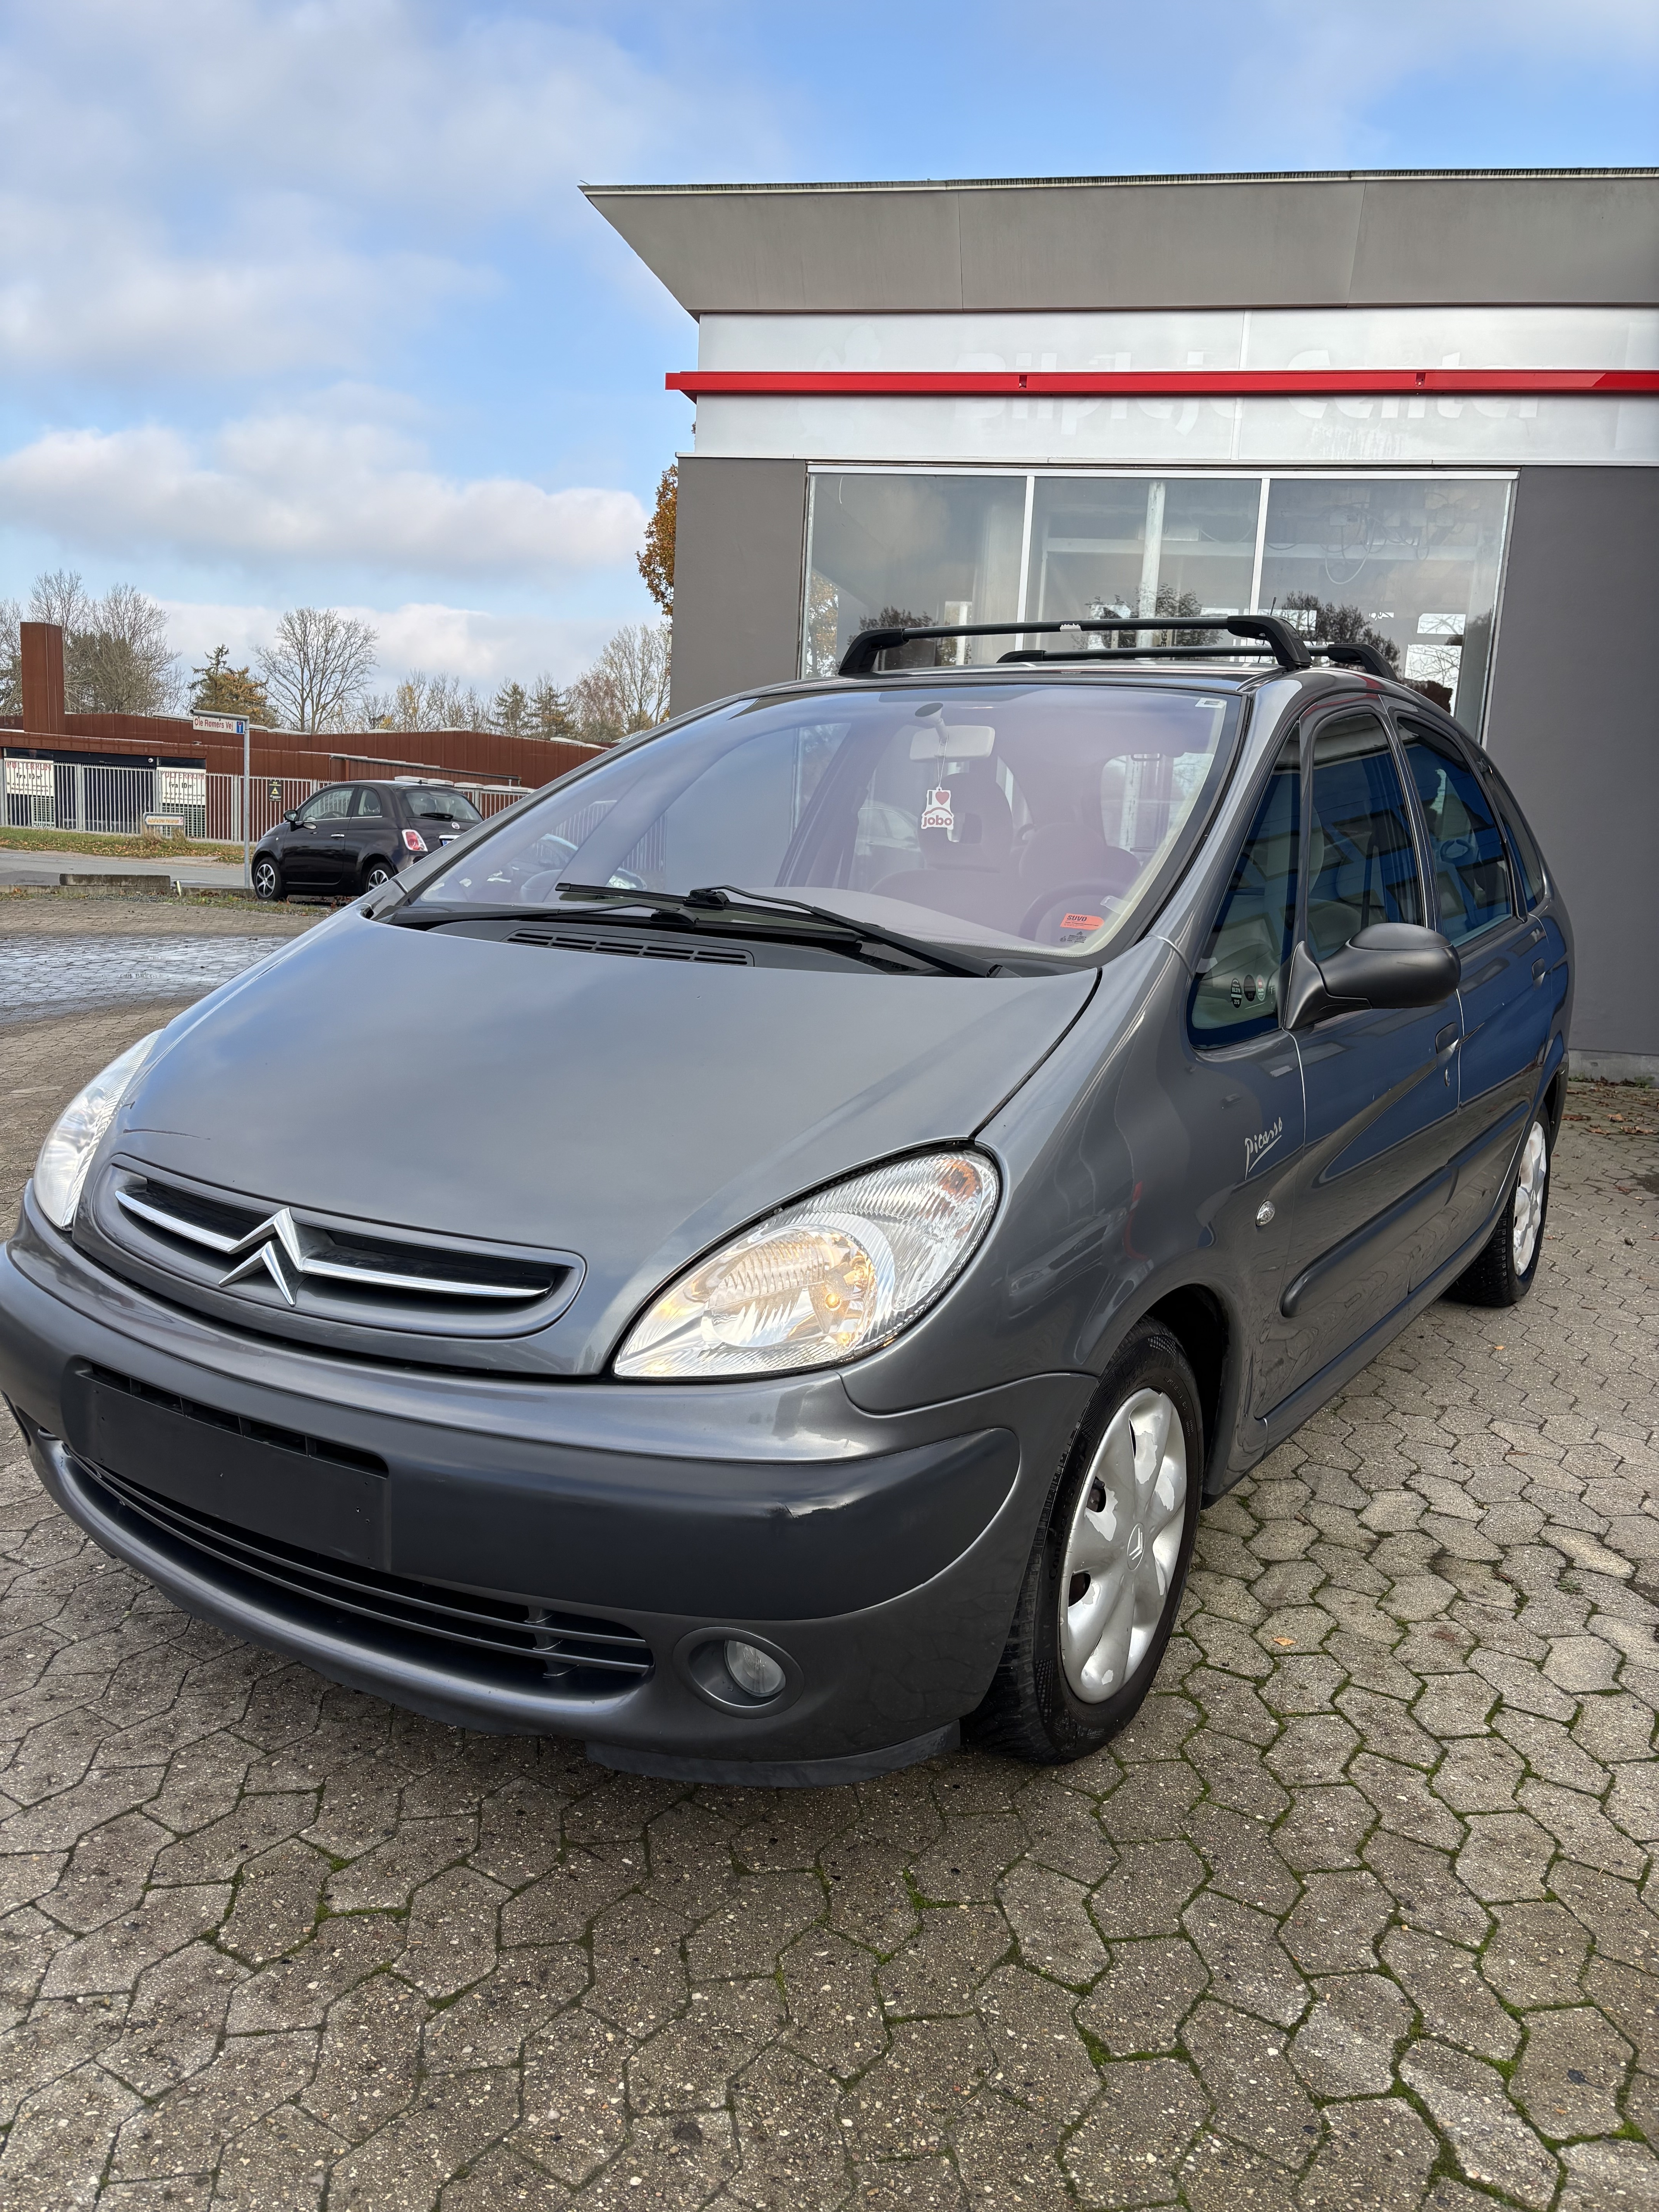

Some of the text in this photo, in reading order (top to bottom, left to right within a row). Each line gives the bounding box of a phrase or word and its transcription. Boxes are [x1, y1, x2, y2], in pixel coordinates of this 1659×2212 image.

[195, 717, 203, 726] Ole
[204, 719, 224, 728] Rømers
[928, 790, 933, 805] I
[923, 815, 952, 827] jobo
[1245, 1116, 1283, 1180] Picasso
